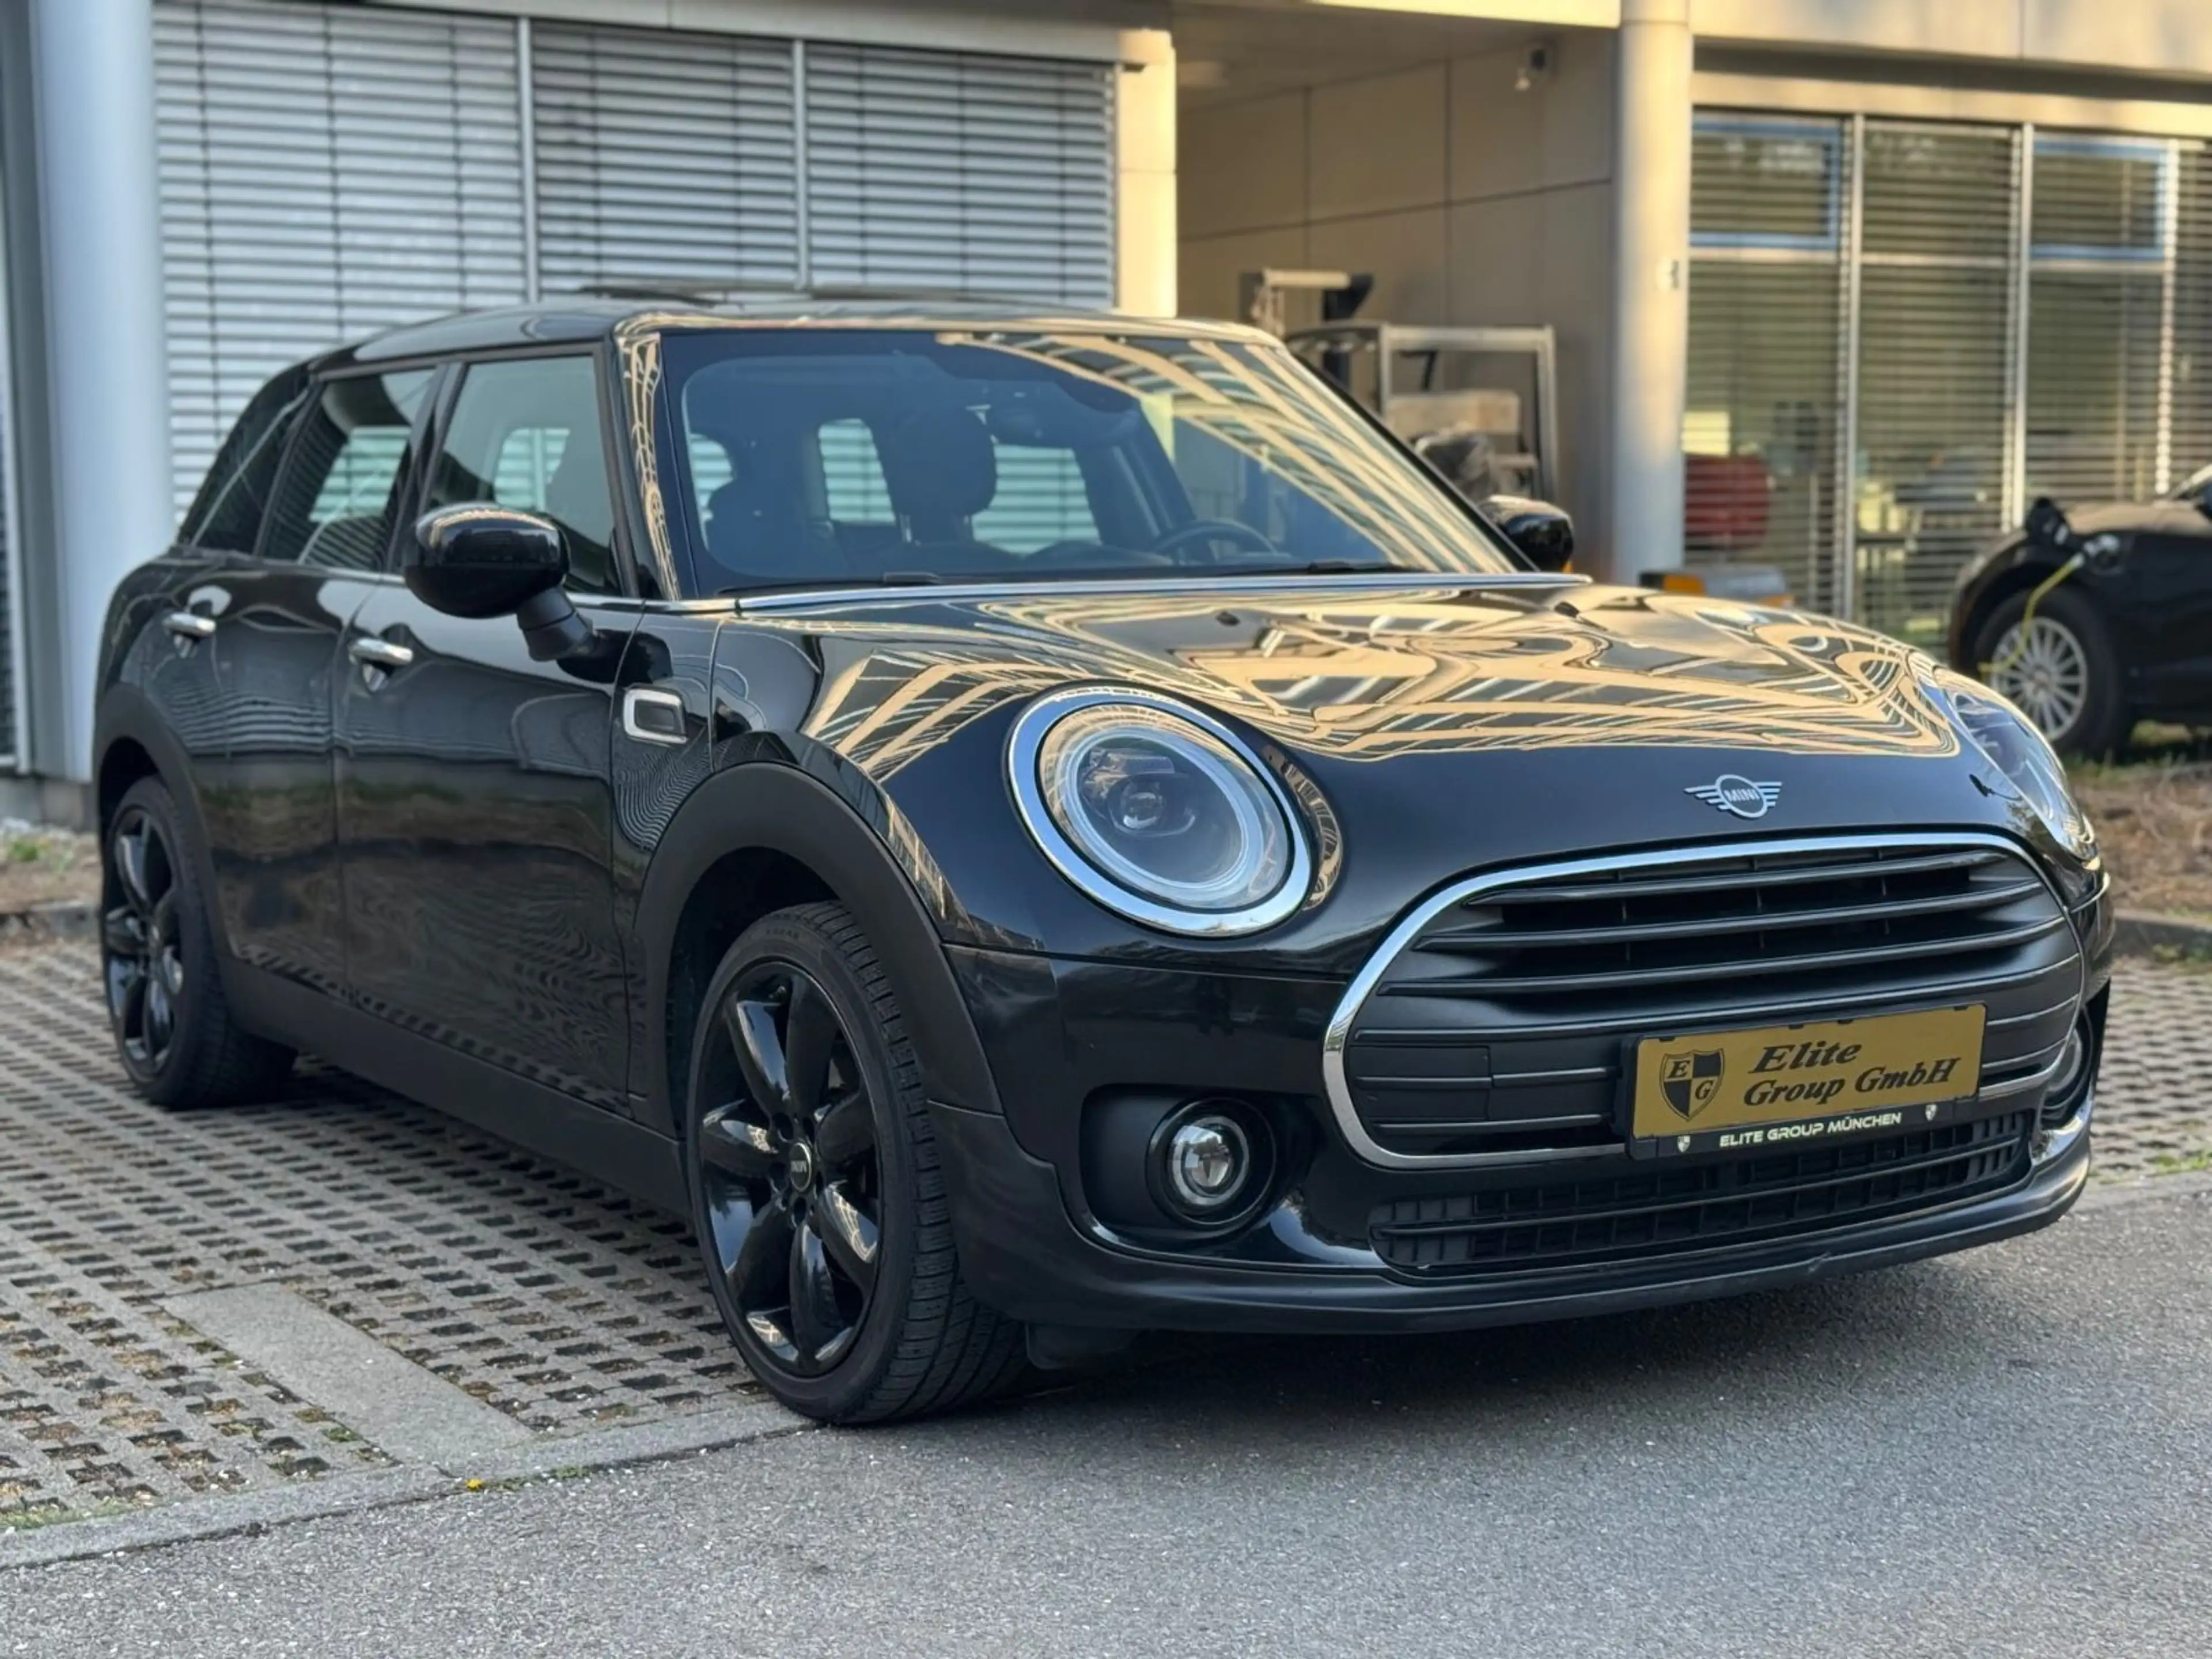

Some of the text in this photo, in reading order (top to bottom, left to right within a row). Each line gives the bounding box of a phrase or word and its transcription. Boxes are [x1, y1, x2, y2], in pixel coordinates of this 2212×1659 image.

[1724, 789, 1760, 801] MINI
[1668, 1060, 1690, 1078] E
[1748, 1040, 1862, 1074] Elite
[1695, 1080, 1713, 1100] G
[1744, 1057, 1961, 1105] Group GmbH
[1719, 1112, 1902, 1147] ELITE GROUP MÜNCHEN
